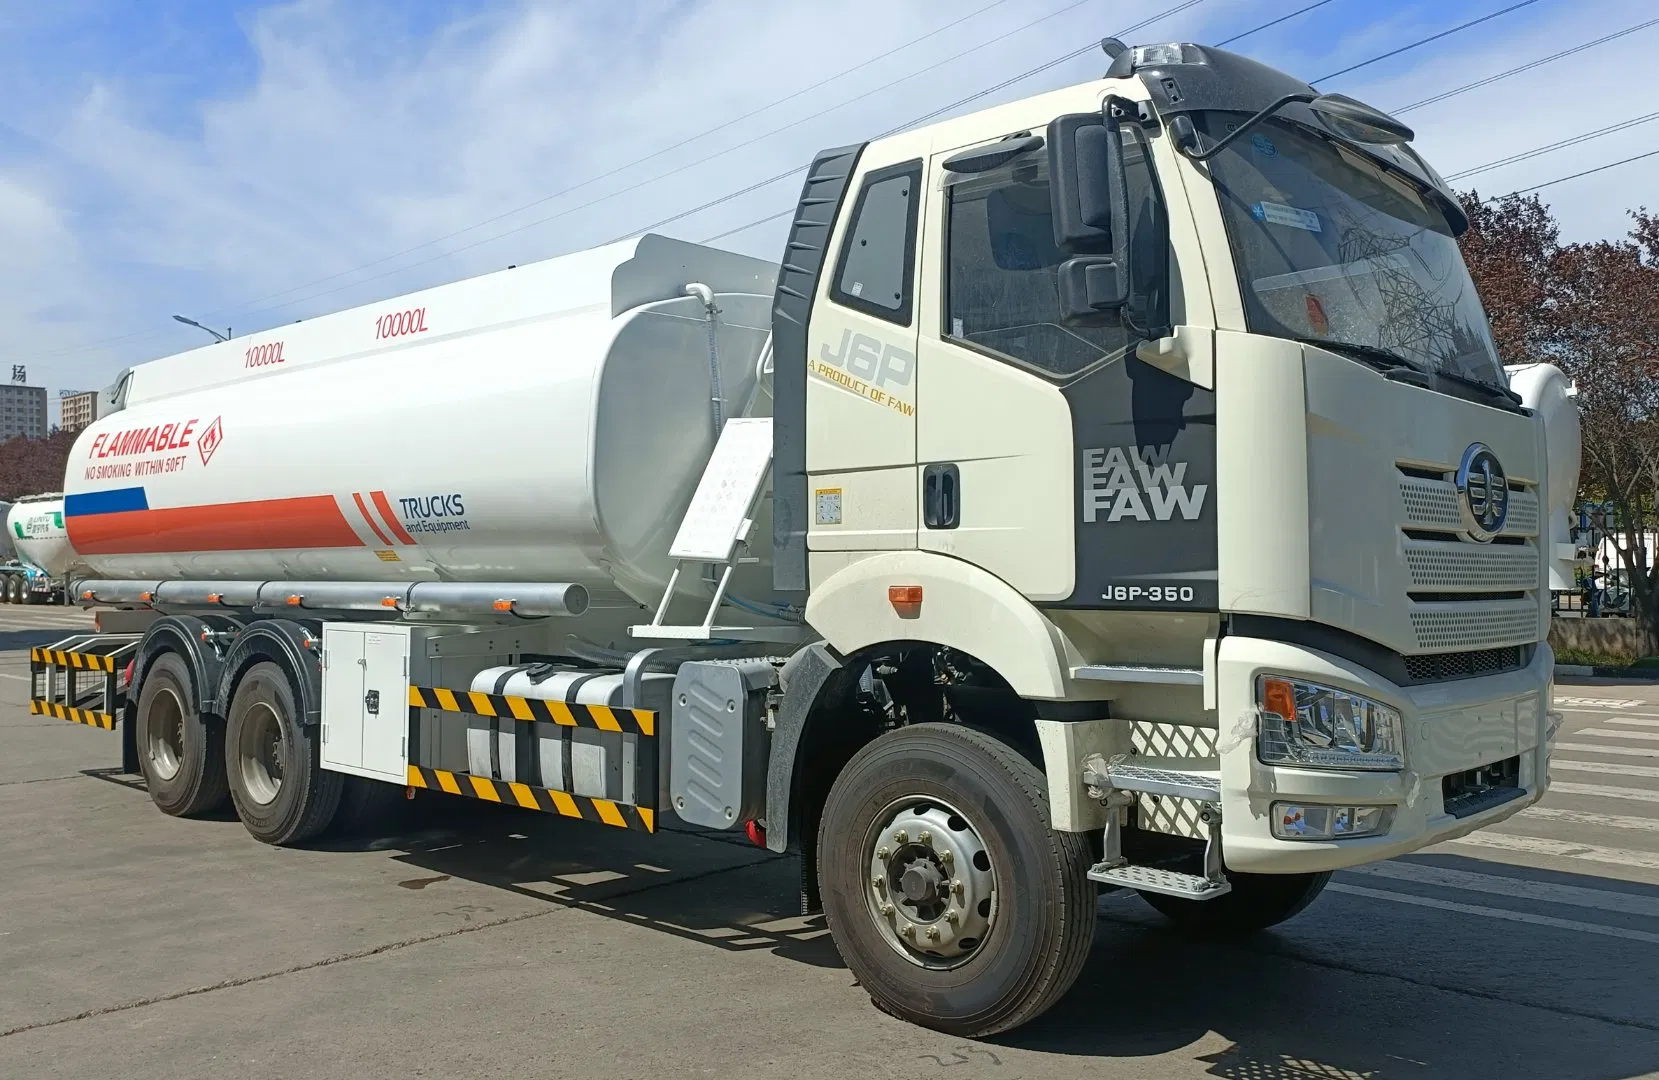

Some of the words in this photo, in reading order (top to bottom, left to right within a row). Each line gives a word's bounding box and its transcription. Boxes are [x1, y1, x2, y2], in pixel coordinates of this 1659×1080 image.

[374, 307, 429, 340] 10000L
[244, 341, 286, 369] 10000L
[820, 327, 917, 389] J6P
[12, 364, 27, 383] 场
[808, 360, 816, 371] A
[818, 363, 869, 395] PRODUCT
[869, 388, 887, 402] OF
[887, 396, 916, 417] FAW
[89, 418, 200, 459] FLAMMABLE
[84, 466, 96, 480] NO
[96, 463, 132, 480] SMOKING
[134, 458, 165, 477] WITHIN
[165, 455, 187, 473] 50FT
[399, 494, 465, 519] TRUCKS
[1083, 484, 1209, 523] FAW
[405, 520, 423, 533] and
[421, 519, 471, 535] Equipment
[1101, 585, 1194, 602] J6P-350
